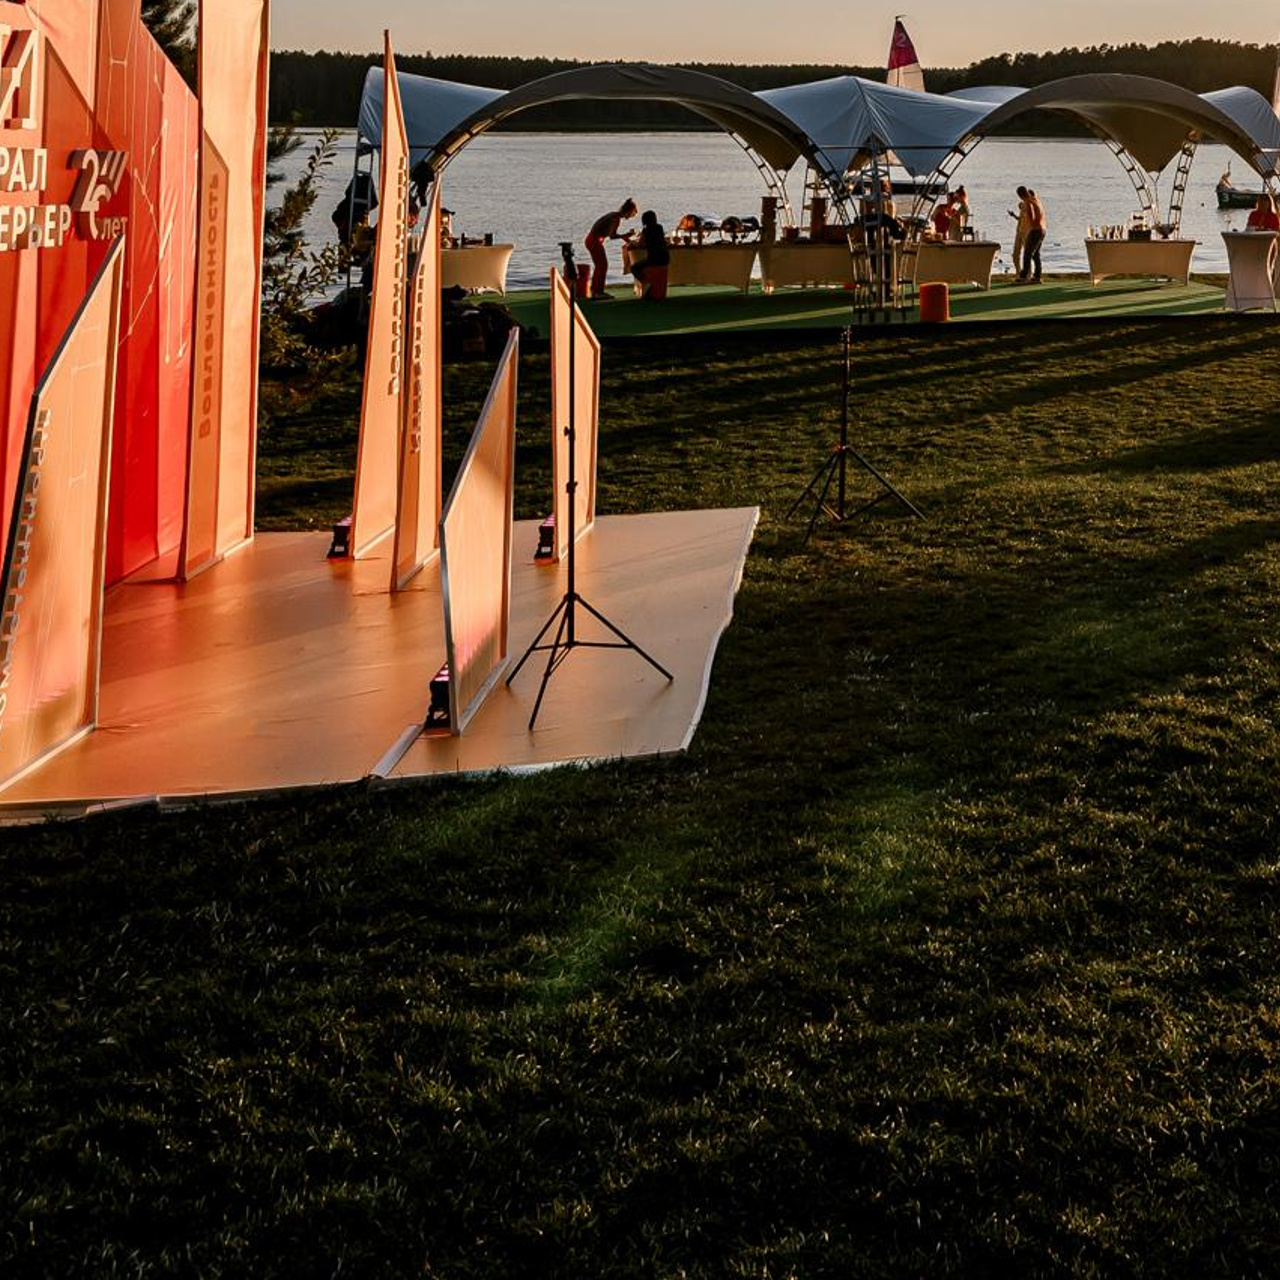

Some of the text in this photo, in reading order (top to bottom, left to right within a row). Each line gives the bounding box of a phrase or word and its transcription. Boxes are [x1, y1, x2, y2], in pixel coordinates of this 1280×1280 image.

[101, 217, 128, 240] лет
[200, 174, 218, 439] Вовлеченность
[0, 408, 51, 730] омпетентность
